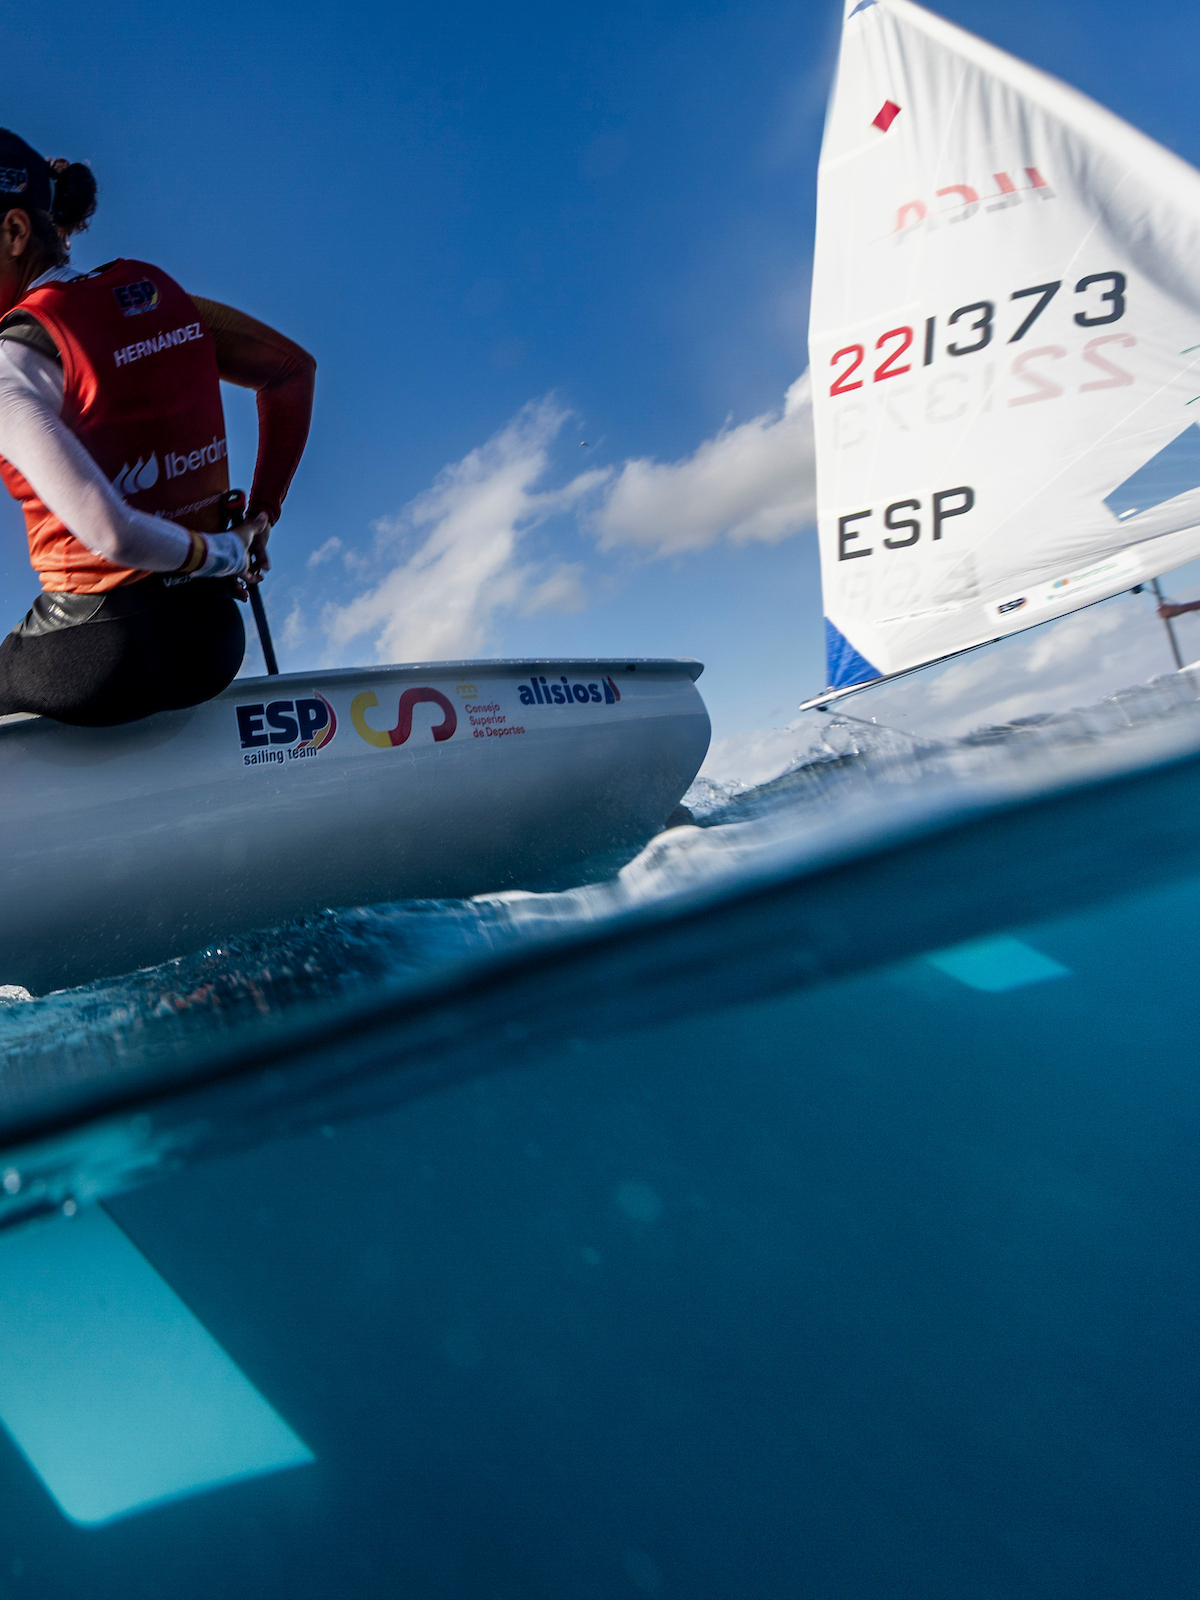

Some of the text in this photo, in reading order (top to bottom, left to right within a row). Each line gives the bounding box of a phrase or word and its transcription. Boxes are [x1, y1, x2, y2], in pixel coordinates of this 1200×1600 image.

[113, 280, 157, 309] ESP
[113, 322, 204, 368] HERNÁNDEZ
[829, 270, 1128, 398] 221373
[837, 485, 975, 562] ESP
[517, 676, 603, 705] alisios
[236, 699, 329, 749] ESP
[465, 702, 501, 717] Consejo
[469, 715, 507, 727] Superior
[473, 725, 526, 738] de Deportes
[243, 745, 318, 765] sailing team
